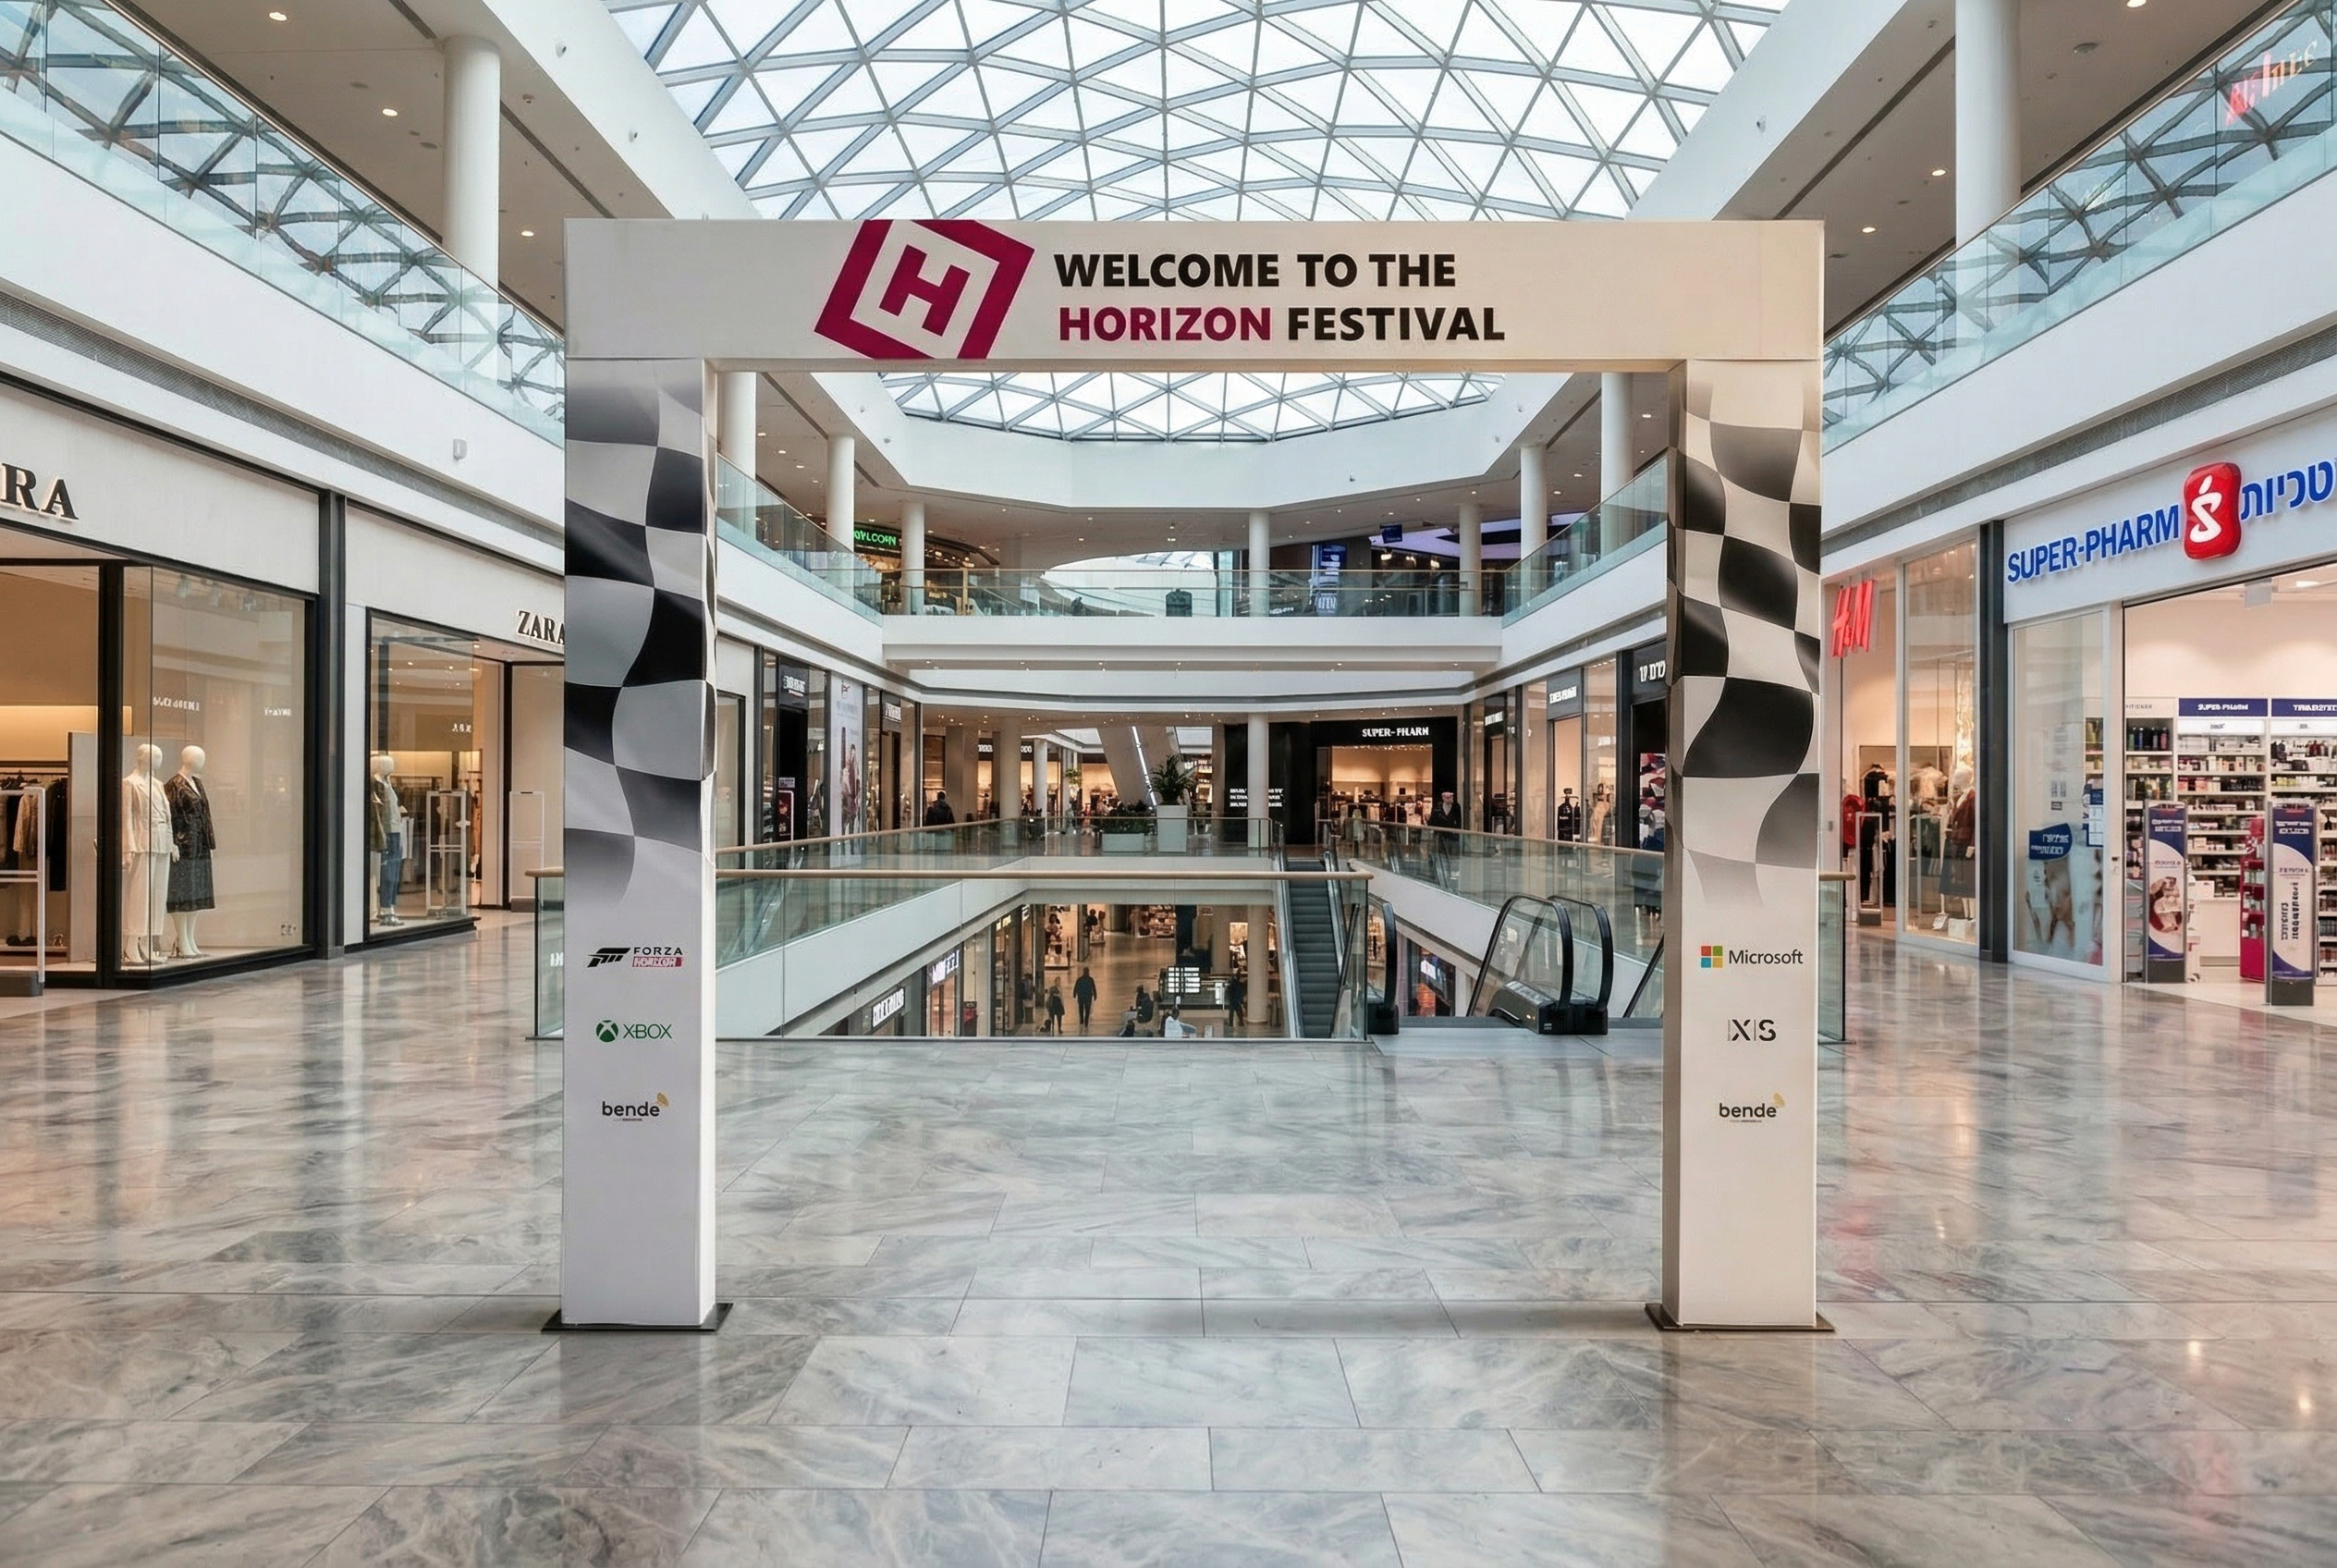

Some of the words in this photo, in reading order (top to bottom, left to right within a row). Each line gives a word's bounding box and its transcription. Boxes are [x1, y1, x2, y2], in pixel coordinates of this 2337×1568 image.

[1054, 252, 1280, 288] WELCOME
[1297, 252, 1359, 288] TO
[1368, 252, 1456, 288] THE
[1058, 306, 1272, 342] HORIZON
[1287, 306, 1506, 342] FESTIVAL
[2007, 504, 2180, 583] SUPER-PHARM
[518, 610, 565, 645] ZARA
[633, 947, 683, 956] FORZA
[1728, 949, 1804, 964] Microsoft
[622, 1023, 673, 1040] XBOX
[602, 1101, 660, 1118] bende
[1719, 1103, 1777, 1119] bende
